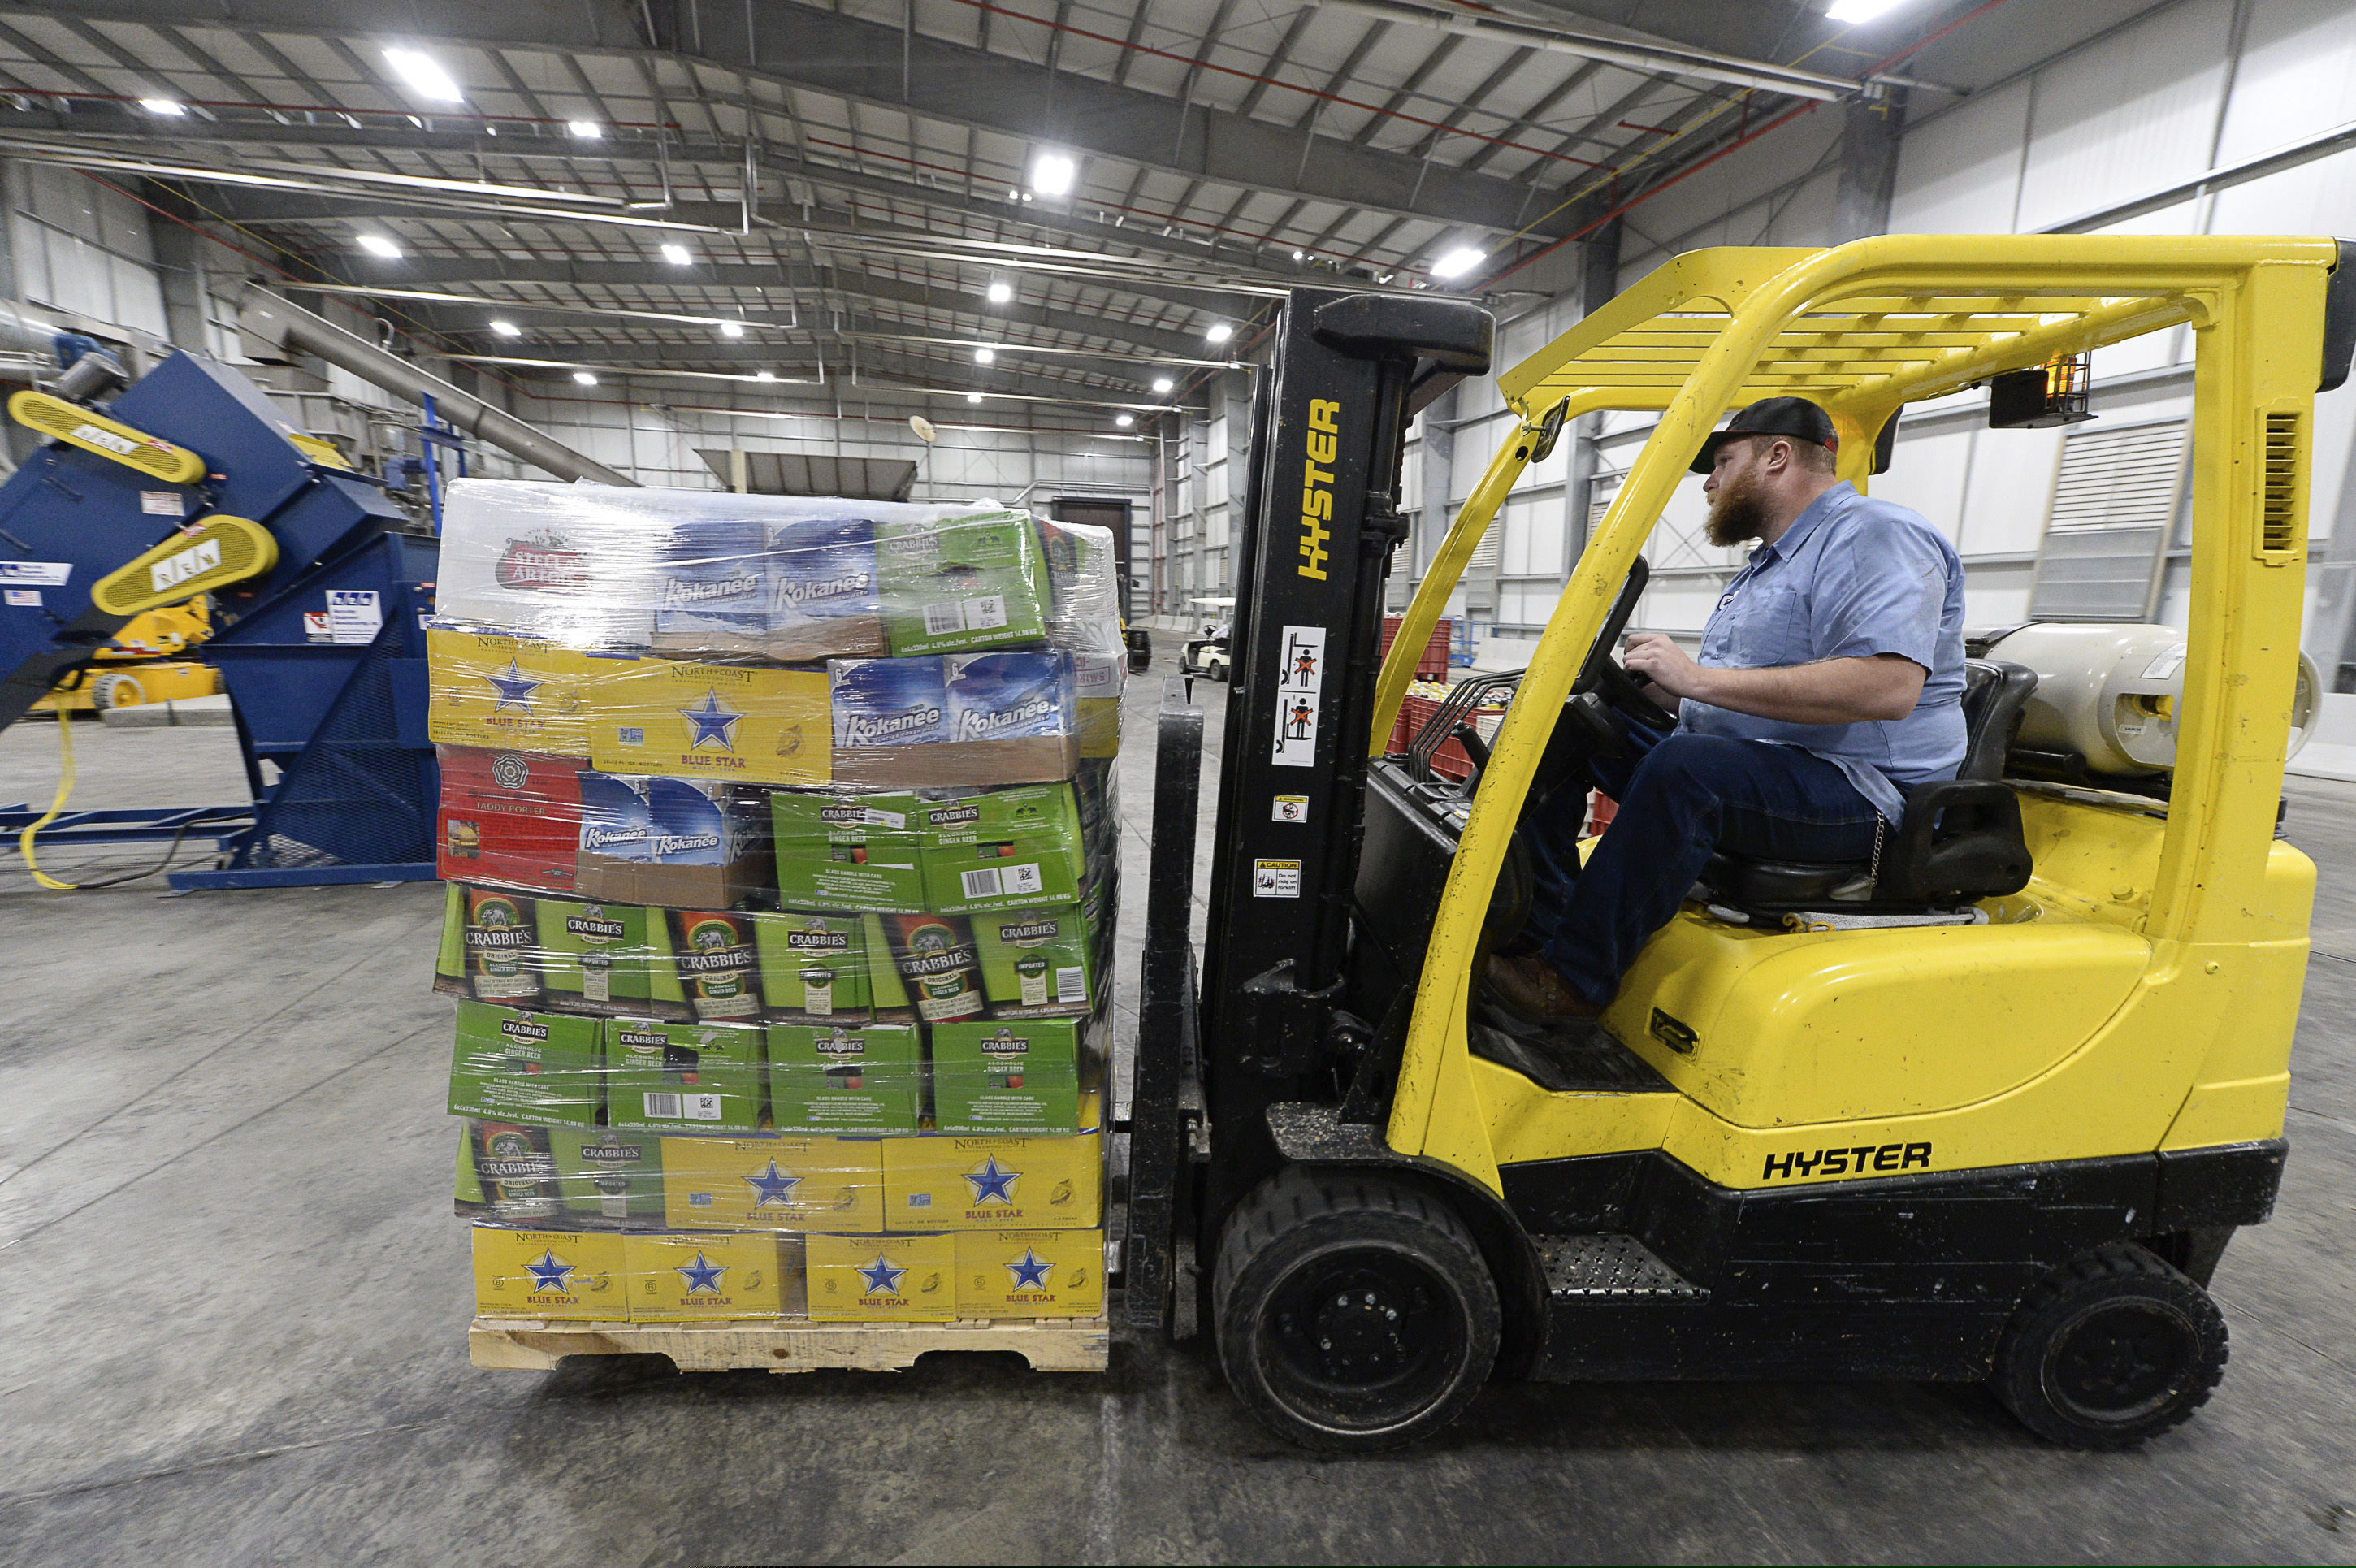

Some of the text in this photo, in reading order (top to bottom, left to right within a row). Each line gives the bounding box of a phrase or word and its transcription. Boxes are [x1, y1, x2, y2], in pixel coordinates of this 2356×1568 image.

[1297, 398, 1340, 581] HYSTER
[774, 573, 871, 611] Kokanee
[478, 637, 513, 648] NORTH
[971, 634, 992, 643] CARTON
[993, 631, 1015, 641] WEIGHT
[672, 665, 756, 683] NORTH COAST
[835, 667, 843, 682] 6
[951, 662, 959, 676] 6
[486, 717, 513, 727] BLUE
[958, 699, 1050, 742] Kokanee
[845, 708, 941, 748] Kokanee
[682, 755, 745, 769] BLUE STAR
[634, 779, 640, 790] 6
[476, 802, 546, 816] TADDY PORTER
[930, 807, 978, 822] CRABBIE'S
[585, 827, 647, 848] Kokanee
[938, 835, 977, 845] GINGER BEER
[656, 835, 718, 856] Kokanee
[568, 920, 623, 935] CRABBIE'S
[1001, 921, 1056, 938] CRABBIE'S
[466, 929, 533, 946] CRABBIE'S
[789, 933, 847, 946] CRABBIE'S
[486, 951, 517, 960] ORIGINAL
[681, 949, 752, 971] CRABBIE'S
[903, 949, 972, 973] CRABBIE'S
[1018, 961, 1046, 969] IMPORTED
[704, 973, 736, 981] ORIGINAL
[927, 973, 957, 983] ORIGINAL
[503, 1022, 548, 1037] CRABBIE'S
[621, 1033, 666, 1044] CRABBIE'S
[505, 1043, 542, 1053] ALCOHOLIC
[817, 1042, 864, 1051] CRABIE'S
[982, 1041, 1028, 1050] CRABBIE'S
[505, 1048, 542, 1059] GINGER BEER
[626, 1059, 647, 1067] GINGER
[522, 1114, 542, 1122] CARTON
[734, 1141, 810, 1152] NORTH COAST
[955, 1137, 1027, 1150] NORTH COAST
[583, 1147, 639, 1159] CRABBIE'S
[1762, 1141, 1933, 1180] HYSTER
[503, 1179, 533, 1187] ORIGINAL
[747, 1213, 805, 1222] BLUE STAR
[965, 1209, 1023, 1219] BLUE STAR
[516, 1233, 578, 1244] NORTH COAST
[998, 1232, 1059, 1241] NORTH COAST
[849, 1239, 912, 1247] NORTH COAST
[527, 1296, 579, 1305] BLUE STAR
[708, 1297, 732, 1306] STAR
[1006, 1294, 1056, 1302] BLUE STAR
